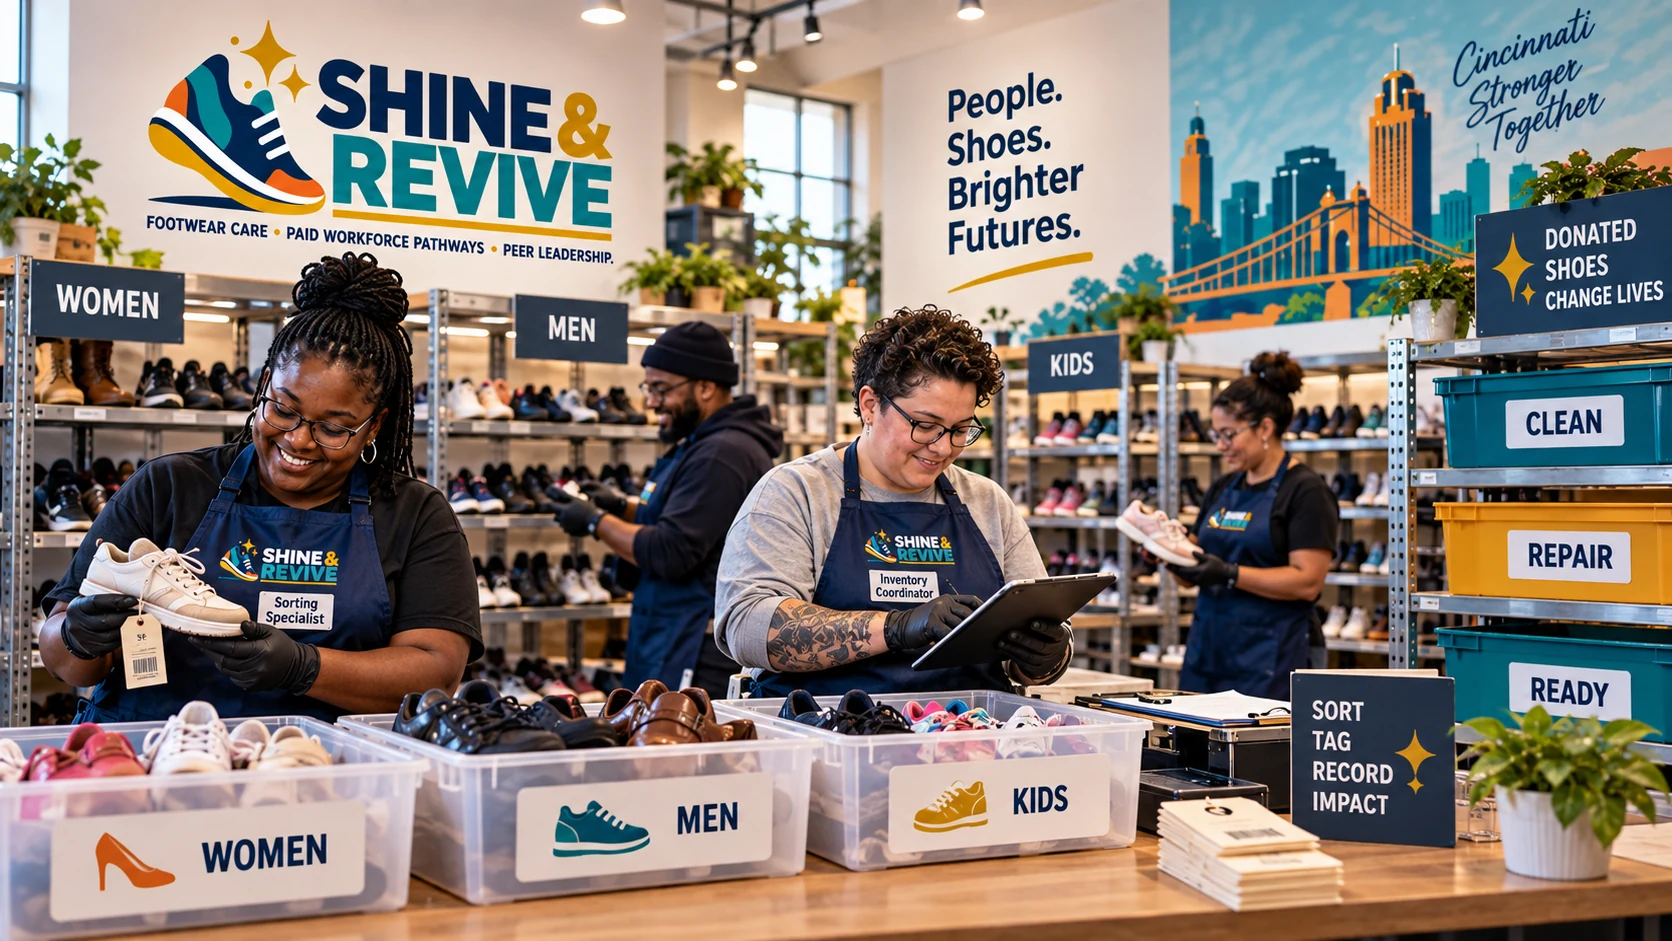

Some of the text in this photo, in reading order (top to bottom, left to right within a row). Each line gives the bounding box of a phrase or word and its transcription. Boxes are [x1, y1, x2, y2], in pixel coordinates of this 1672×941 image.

[1453, 8, 1596, 87] Cincinnati
[948, 72, 1062, 123] People.
[1466, 59, 1583, 129] Stronger
[1485, 89, 1606, 153] Together
[947, 125, 1051, 166] Shoes.
[333, 134, 612, 229] REVIVE
[948, 163, 1084, 212] Brighter
[146, 215, 614, 264] FOOTWEAR CARE PAID WORKFORCE PATHWAYS PEER LEADERSHIP.
[948, 213, 1081, 255] Futures.
[1545, 219, 1637, 250] DONATED
[1545, 254, 1609, 281] SHOES
[56, 283, 160, 320] WOMEN
[1545, 280, 1664, 311] CHANGE LIVES
[548, 314, 596, 343] MEN
[1050, 351, 1094, 377] KIDS
[1526, 409, 1602, 436] CLEAN
[897, 548, 954, 562] REVIVE
[1528, 542, 1613, 570] REPAIR
[260, 563, 338, 582] REVIVE
[880, 573, 927, 587] Inventory
[274, 596, 318, 612] Sorting
[875, 587, 934, 599] Coordinator
[265, 611, 325, 626] Specialist
[1531, 677, 1609, 707] READY
[1312, 700, 1364, 721] SORT
[1312, 730, 1351, 751] TAG
[1313, 761, 1394, 784] RECORD
[1013, 784, 1069, 815] KIDS
[1313, 791, 1389, 815] IMPACT
[677, 801, 738, 835] MEN
[201, 833, 327, 873] WOMEN
